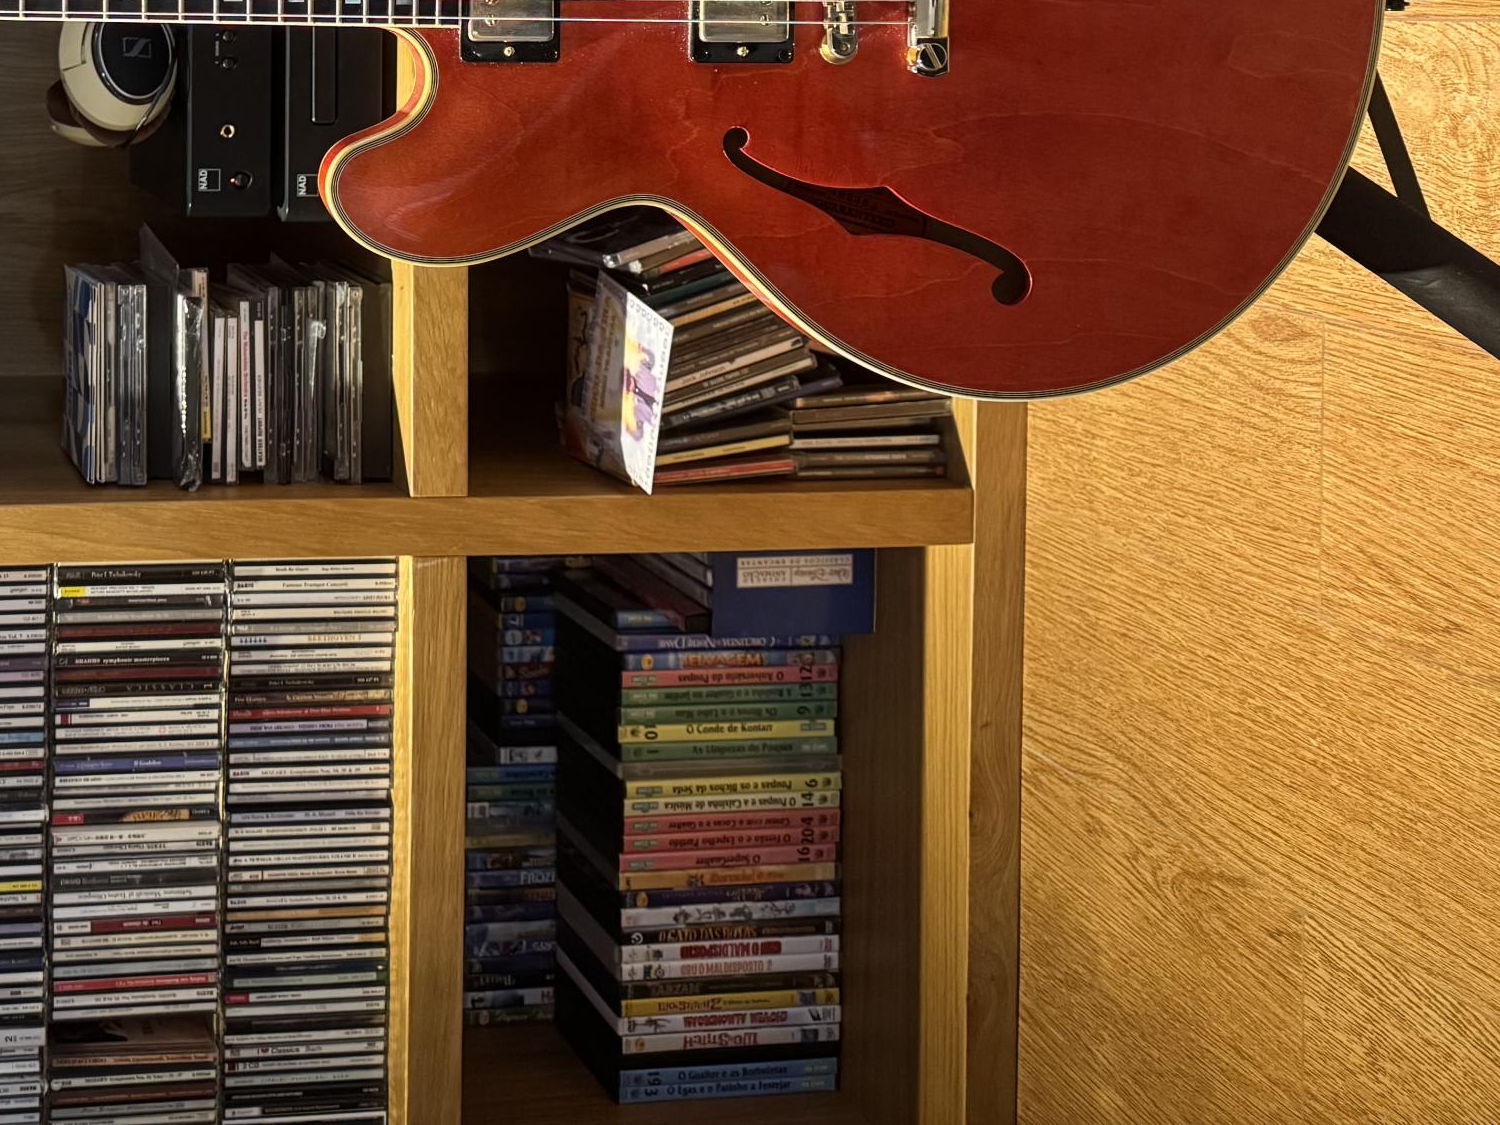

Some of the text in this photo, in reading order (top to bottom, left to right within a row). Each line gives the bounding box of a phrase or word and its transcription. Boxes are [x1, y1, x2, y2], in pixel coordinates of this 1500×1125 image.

[199, 169, 208, 190] NAD
[298, 175, 307, 196] NAD
[712, 673, 723, 682] do
[697, 784, 707, 793] da
[740, 782, 750, 790] os
[761, 779, 792, 789] Poupas
[673, 785, 693, 794] Seda
[664, 801, 692, 811] Música
[696, 800, 705, 810] de
[708, 799, 741, 809] Caixinha
[758, 797, 787, 807] Poupas
[789, 796, 796, 806] O
